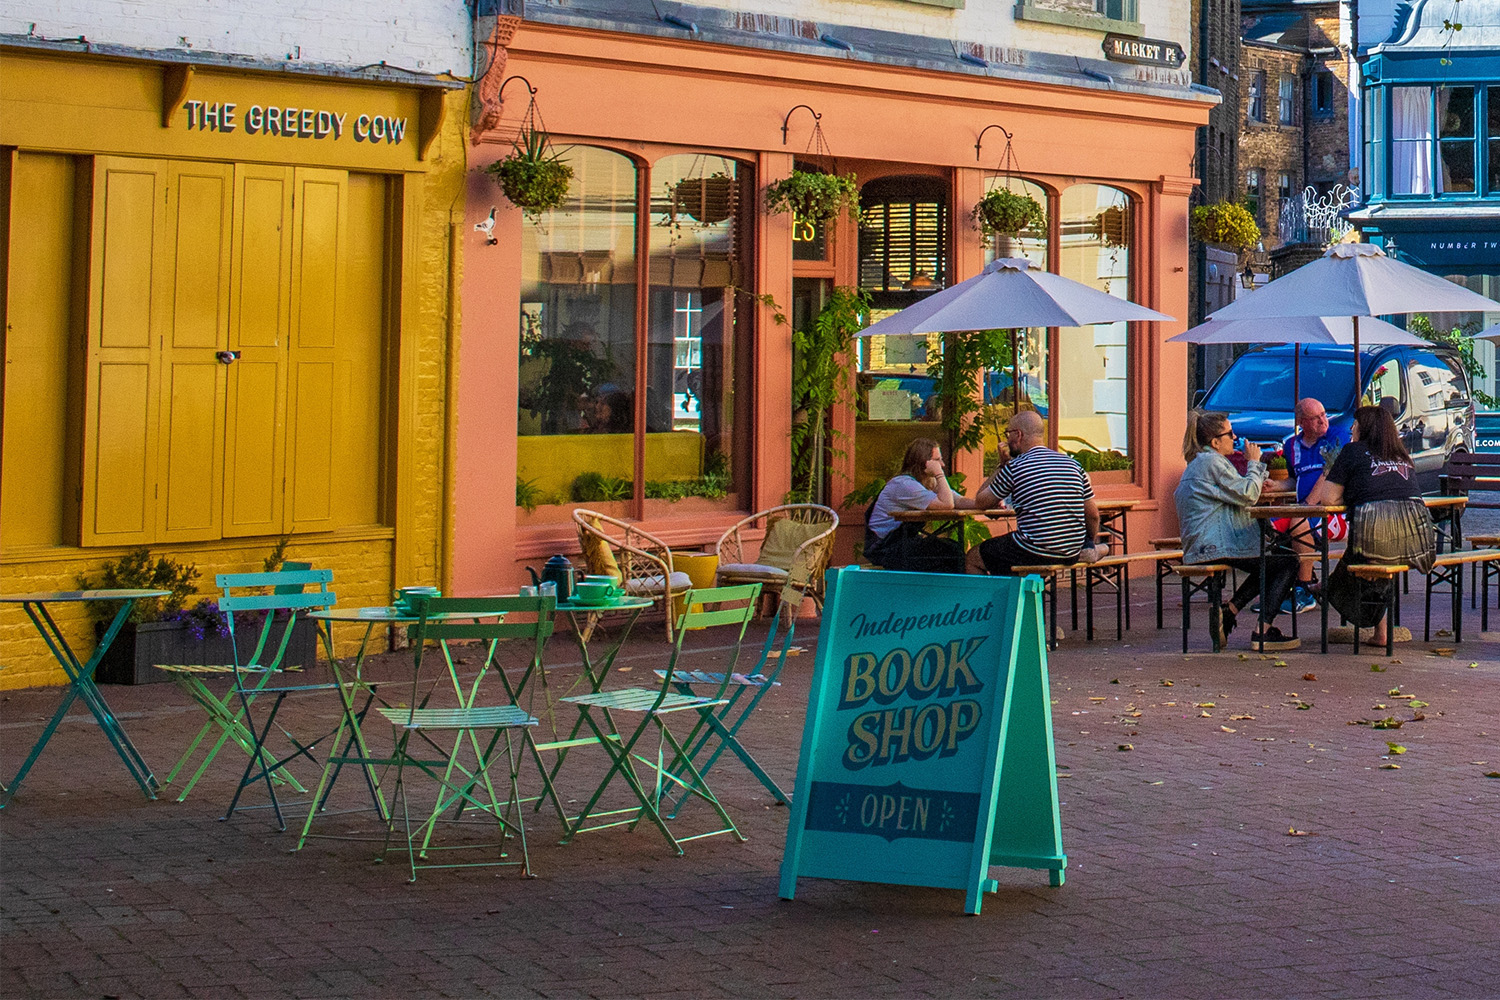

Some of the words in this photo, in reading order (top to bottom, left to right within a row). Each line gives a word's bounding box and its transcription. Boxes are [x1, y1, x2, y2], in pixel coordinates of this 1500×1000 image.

[1114, 40, 1160, 60] MARKET
[184, 100, 237, 131] THE
[247, 105, 347, 138] GREEDY
[355, 114, 407, 143] COW
[1475, 439, 1500, 447] E.COM
[850, 601, 994, 640] Independent
[838, 636, 988, 709] BOOK
[843, 699, 982, 769] SHOP
[860, 793, 932, 832] OPEN
